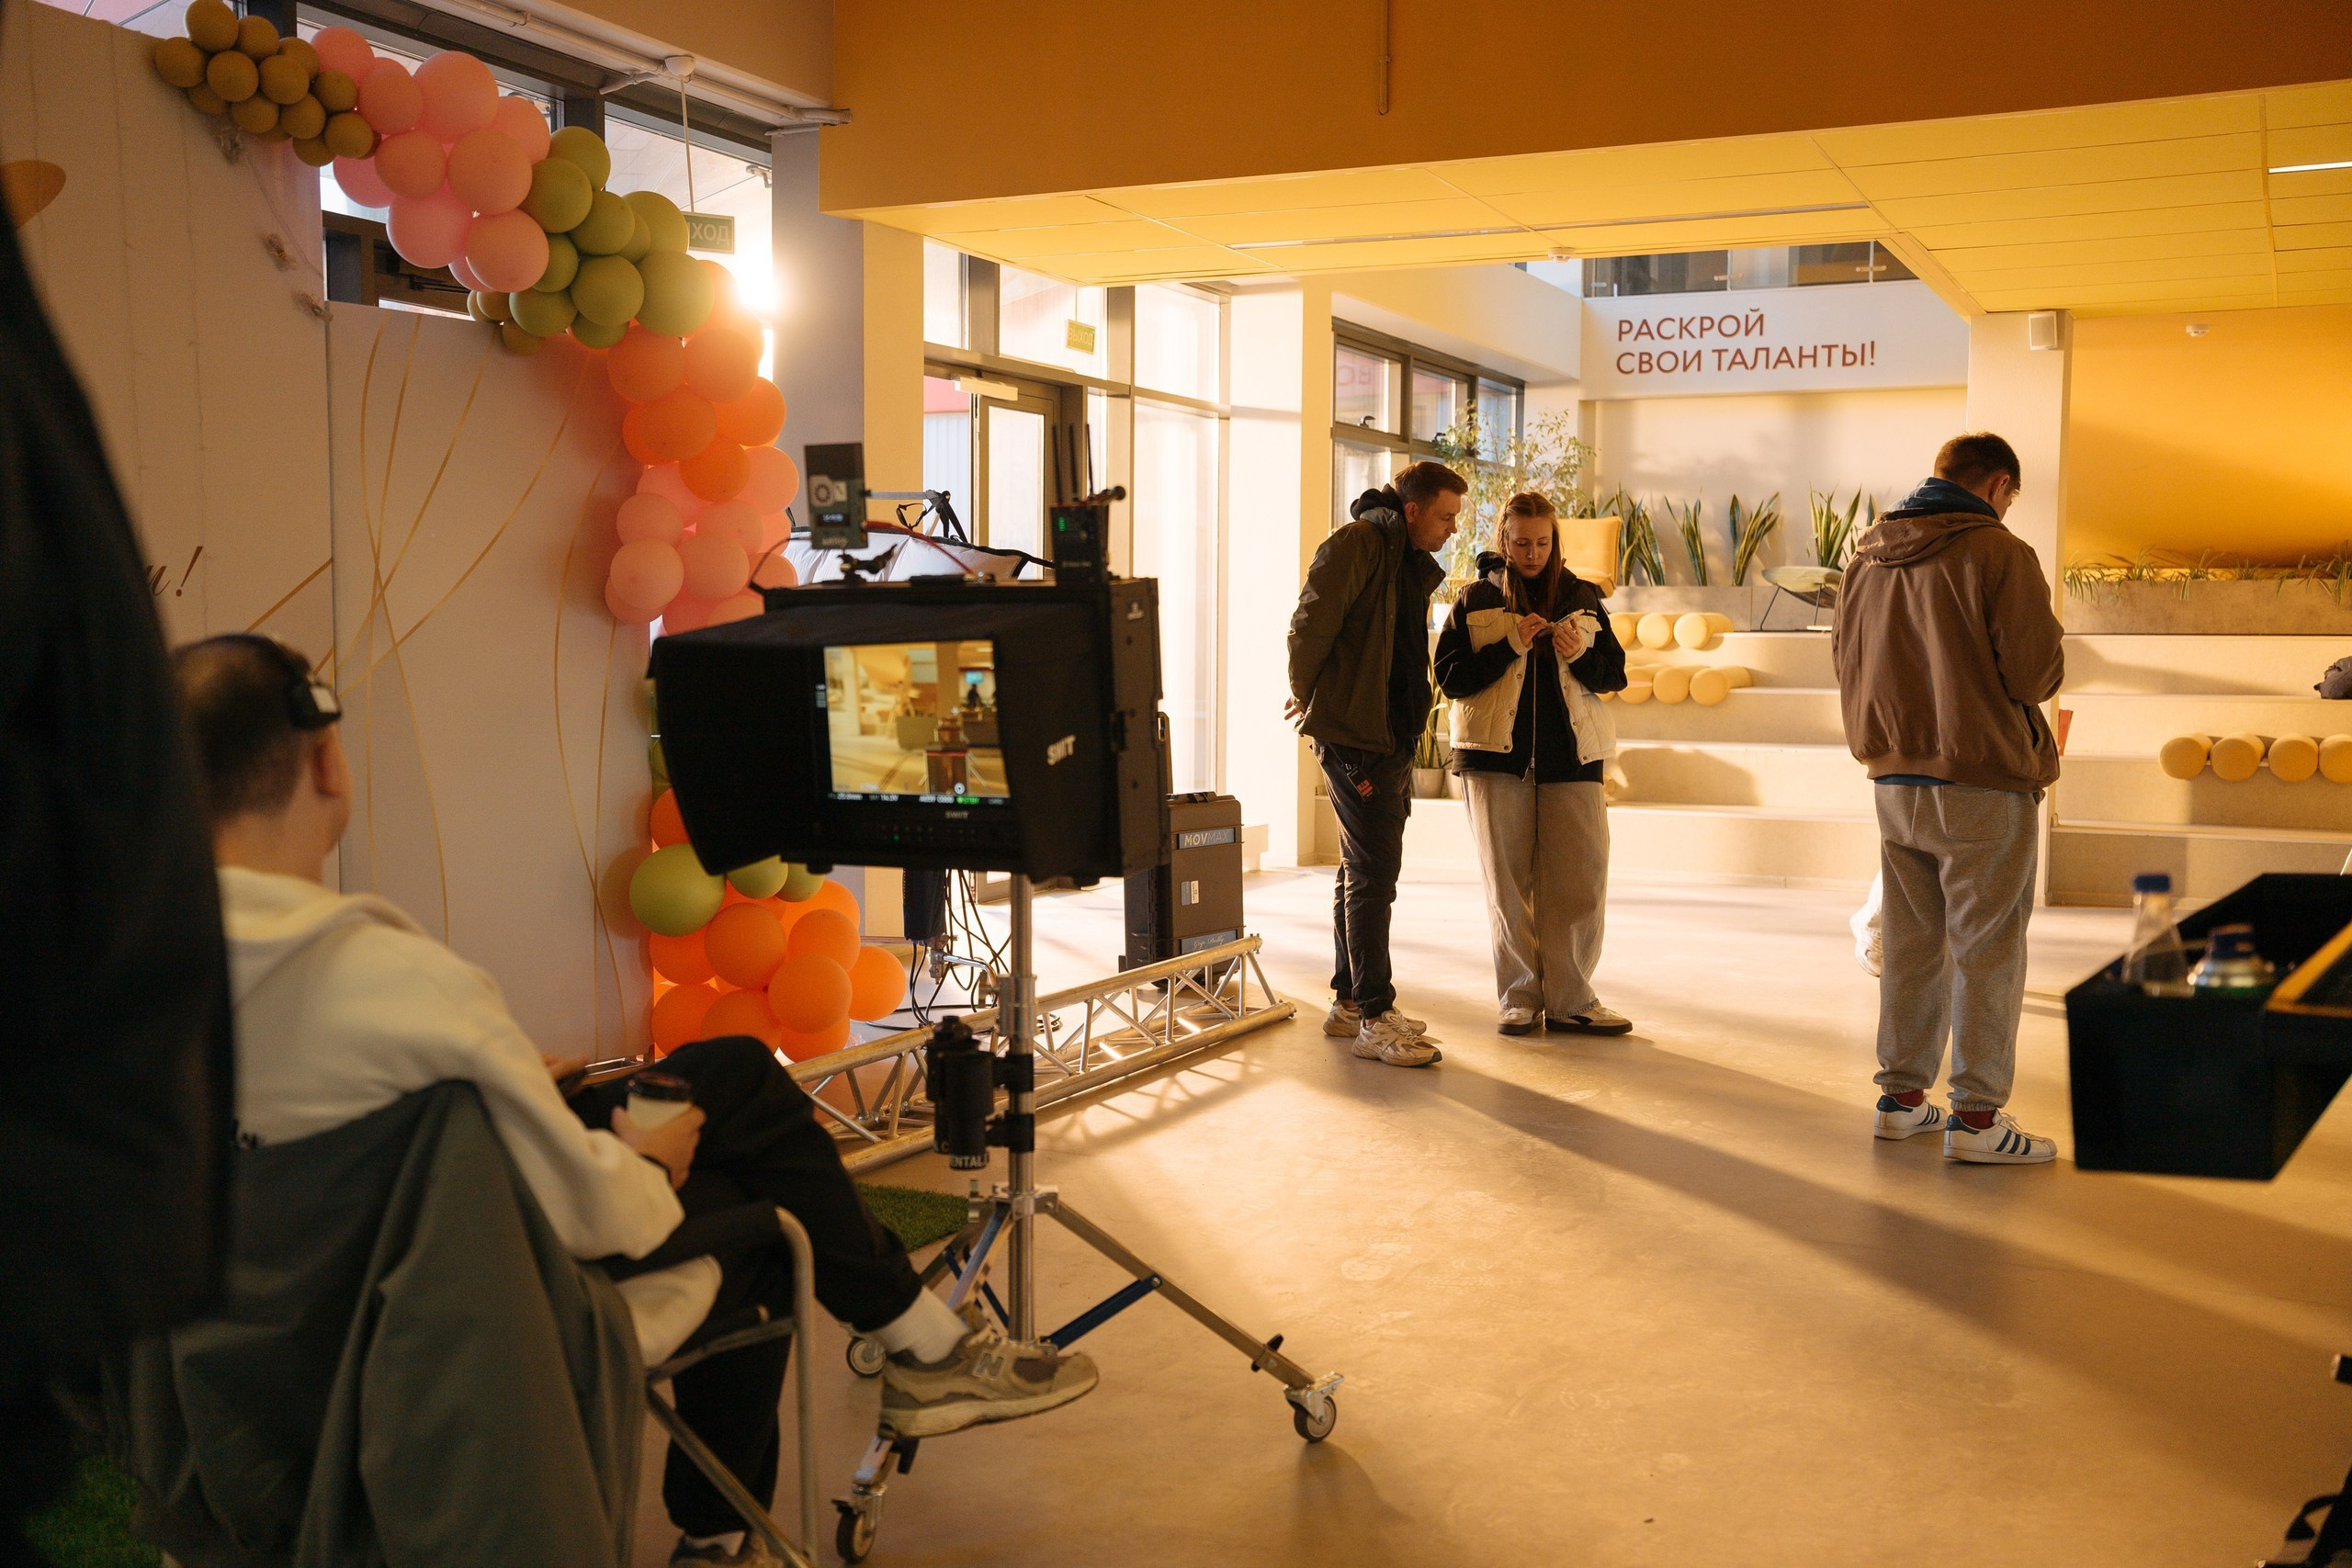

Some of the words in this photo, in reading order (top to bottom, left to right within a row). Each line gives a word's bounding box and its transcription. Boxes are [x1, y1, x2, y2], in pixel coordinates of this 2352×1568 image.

[686, 222, 729, 246] ХОД
[1618, 309, 1764, 342] РАСКРОЙ
[1068, 327, 1093, 346] ВЫХОД
[1616, 350, 1702, 375] СВОИ
[1712, 341, 1875, 372] ТАЛАНТЫ!
[1184, 830, 1229, 846] MOVMAX
[950, 1153, 988, 1168] ENTAL
